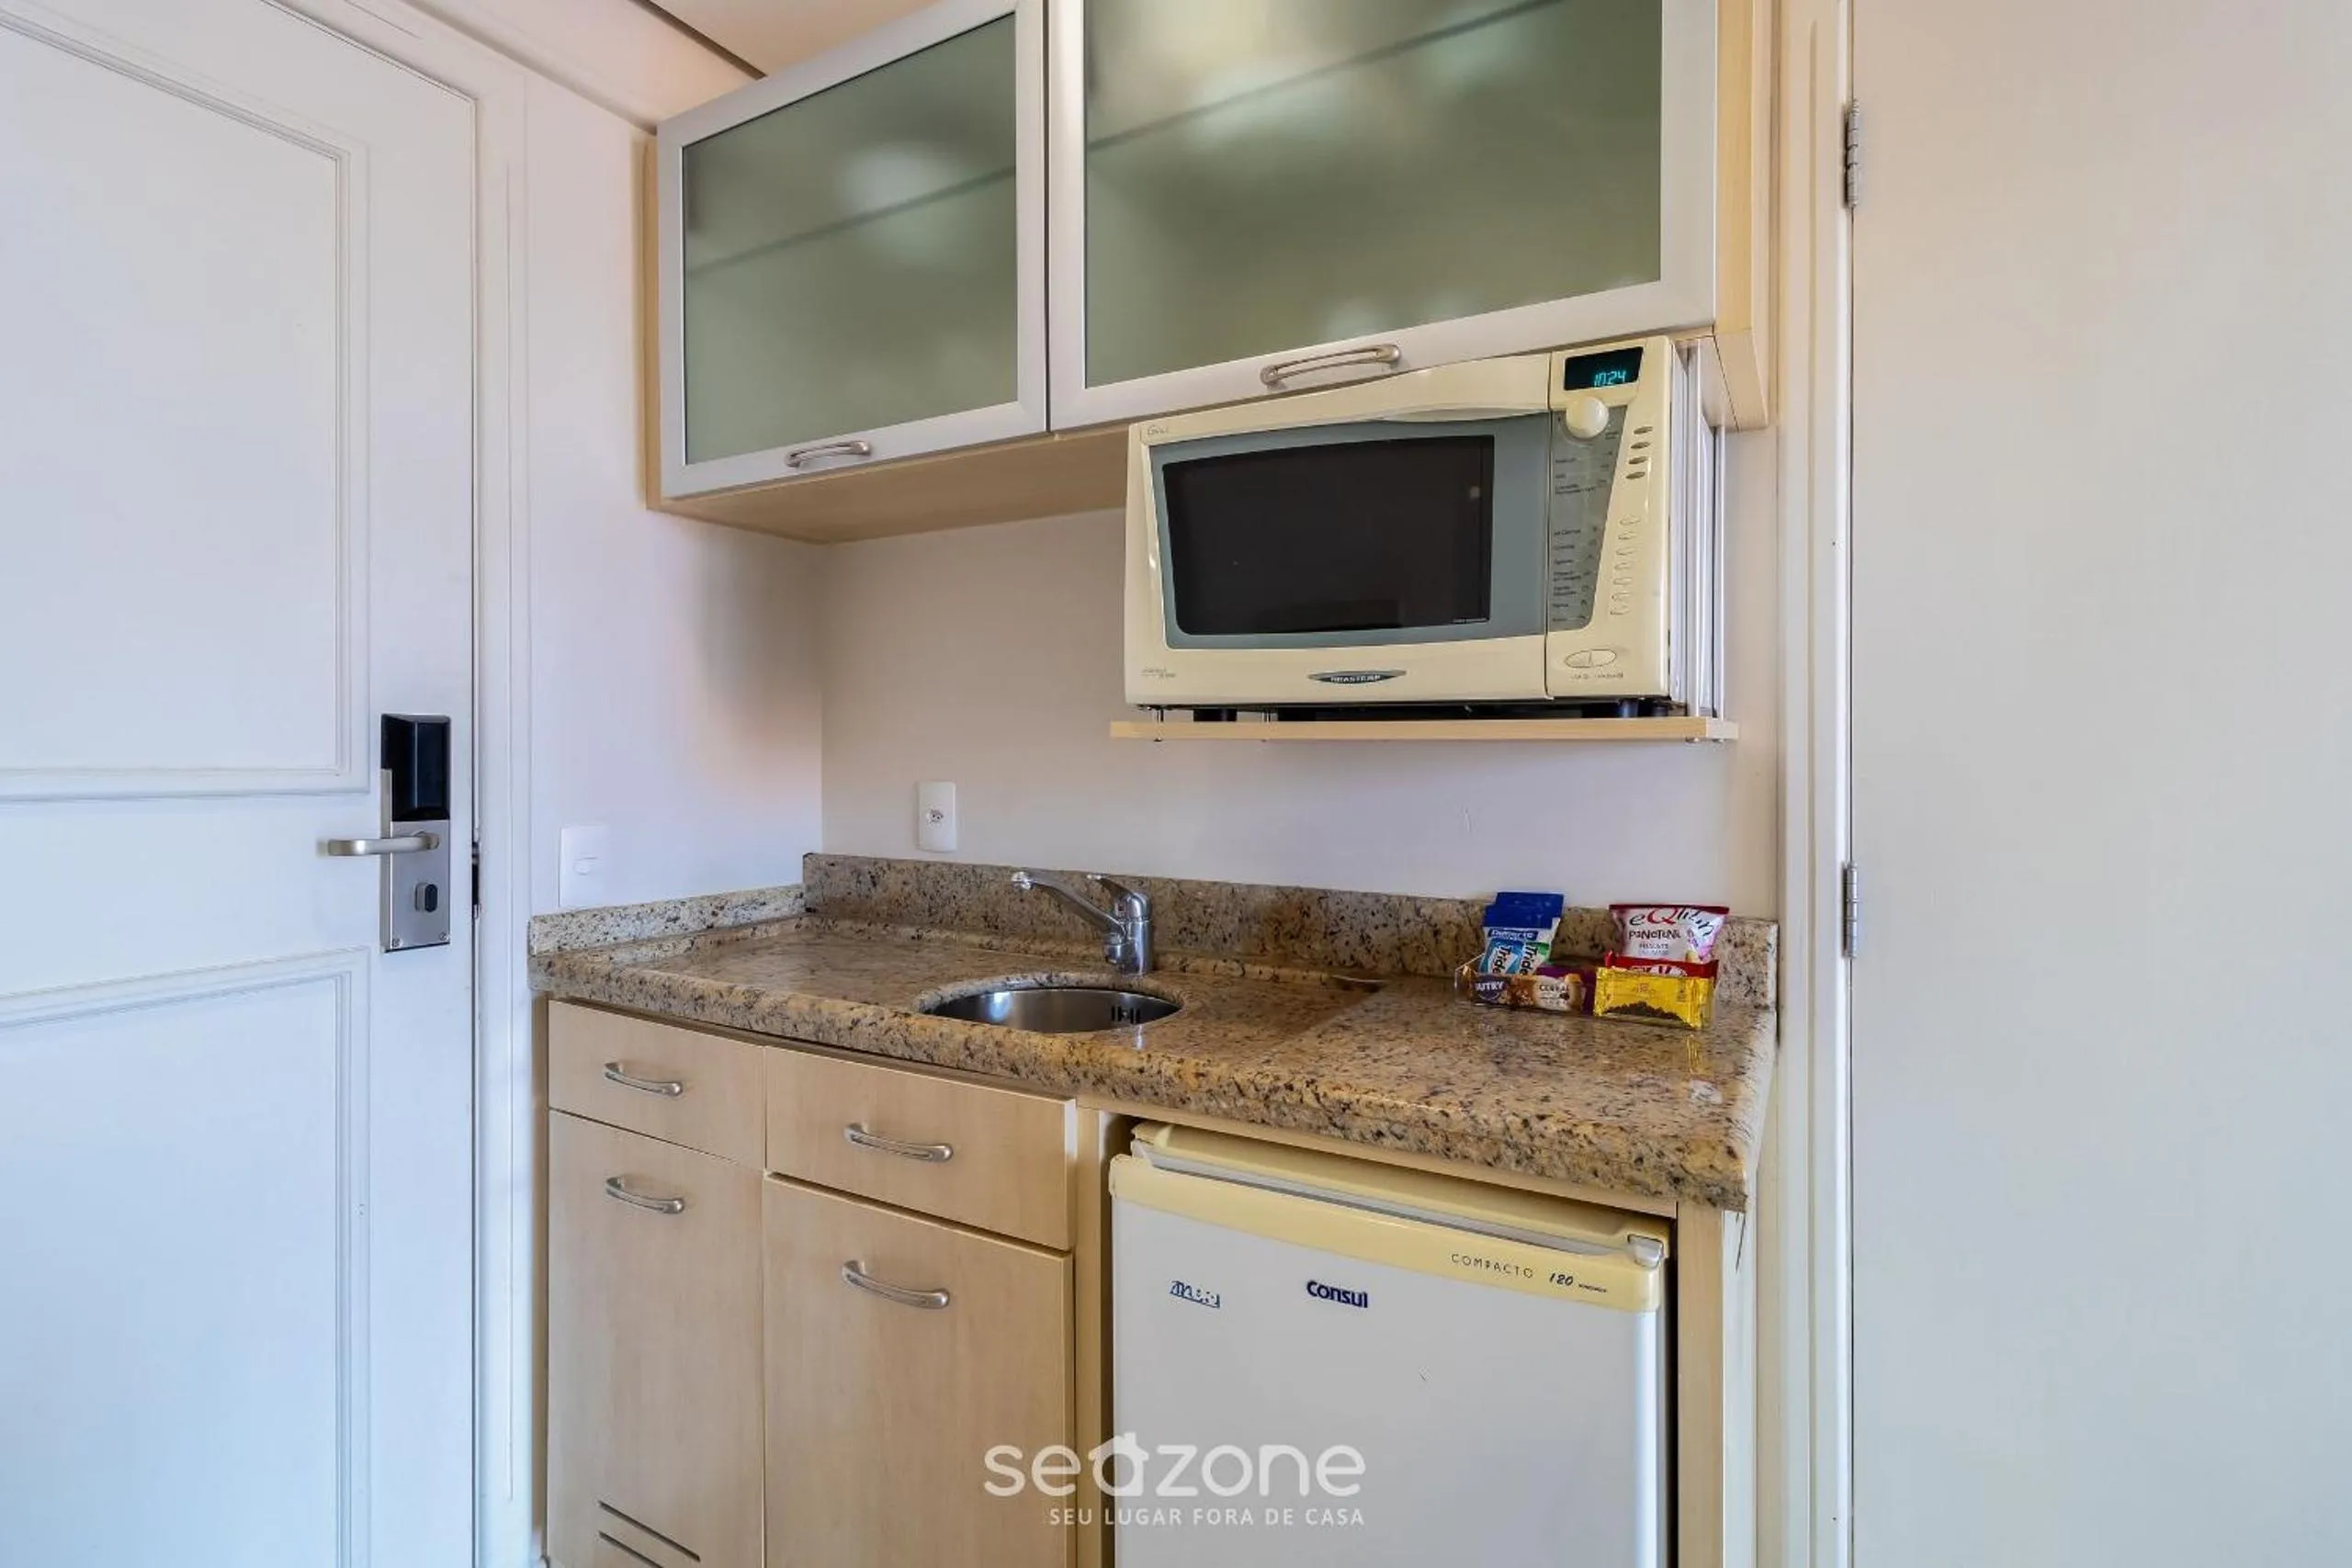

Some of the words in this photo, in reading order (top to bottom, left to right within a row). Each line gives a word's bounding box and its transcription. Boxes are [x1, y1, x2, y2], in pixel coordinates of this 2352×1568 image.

[1451, 1253, 1533, 1279] COMPACTO
[1549, 1272, 1574, 1286] 120
[1306, 1280, 1368, 1309] Consul
